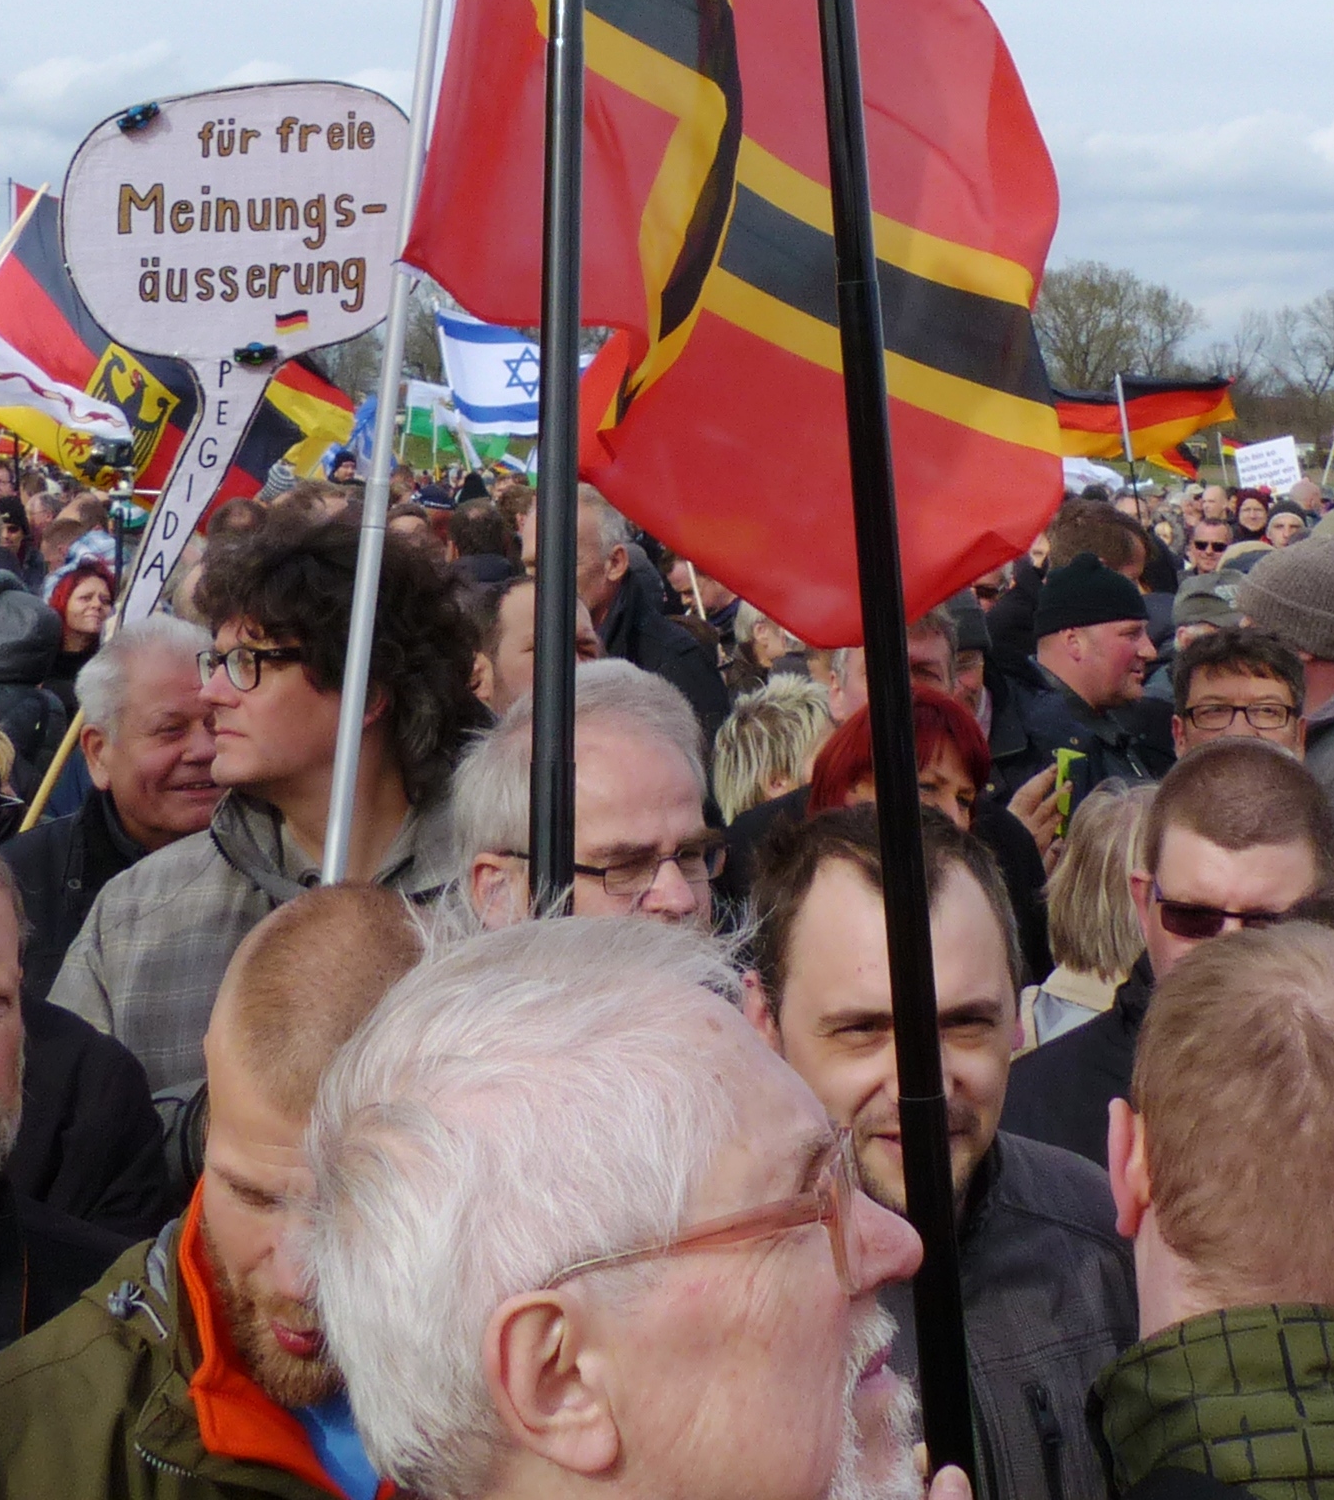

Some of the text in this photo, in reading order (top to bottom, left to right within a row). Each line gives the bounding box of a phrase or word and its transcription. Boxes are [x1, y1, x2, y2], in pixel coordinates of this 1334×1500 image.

[198, 110, 376, 158] für freie
[117, 183, 388, 250] Meinungs-
[139, 256, 367, 313] äusserung
[142, 359, 234, 588] PEGIDA
